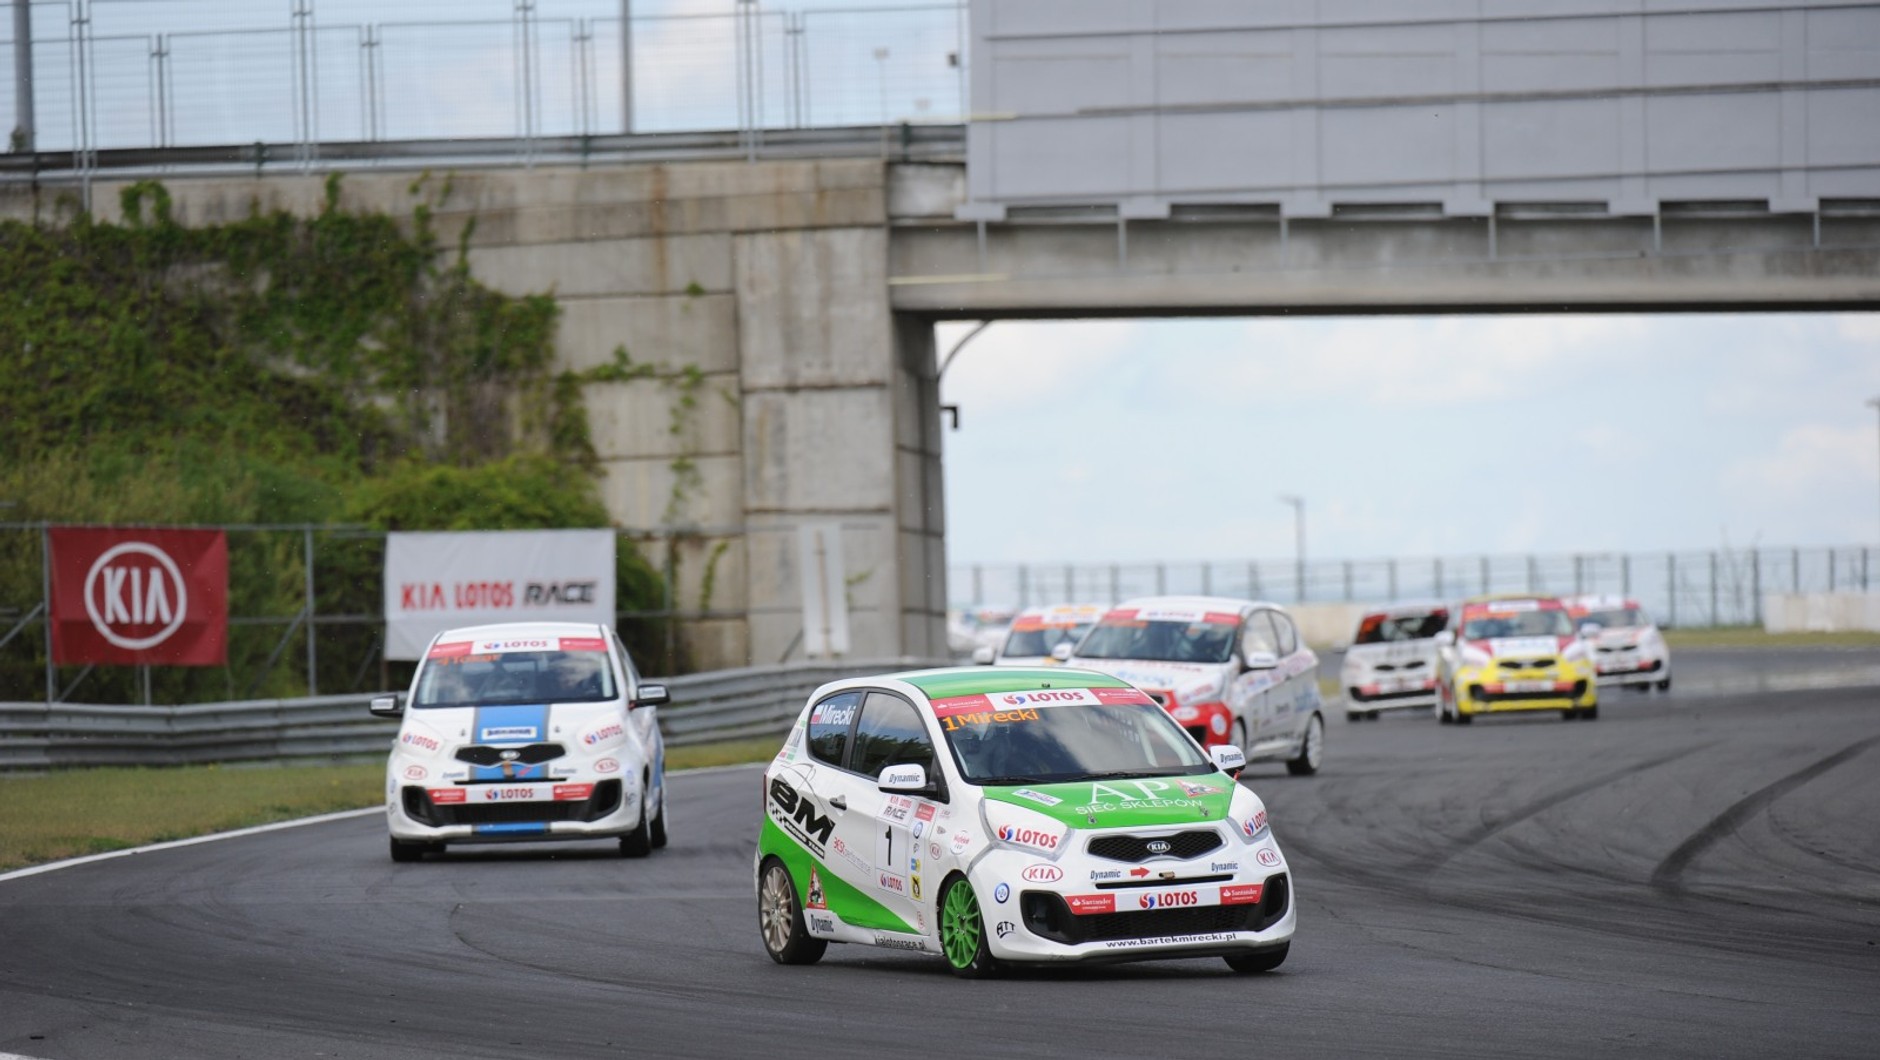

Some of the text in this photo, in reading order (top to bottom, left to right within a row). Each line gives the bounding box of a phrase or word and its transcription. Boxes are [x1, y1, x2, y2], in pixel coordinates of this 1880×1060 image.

[103, 566, 172, 624] KIA
[401, 581, 597, 609] KIA LOTOS RACE
[504, 640, 548, 648] LOTOS
[1028, 691, 1084, 702] LOTOS
[819, 704, 857, 725] Mirecki
[596, 724, 623, 740] LOTOS
[412, 735, 439, 751] LOTOS
[1220, 751, 1243, 764] Dynamic
[888, 773, 921, 784] Dynamic
[501, 788, 534, 799] LOTOS
[1087, 781, 1170, 805] AP
[769, 778, 836, 846] BM
[883, 805, 908, 820] RACE
[885, 825, 893, 866] 1
[1016, 830, 1058, 849] LOTOS
[1151, 842, 1168, 851] KIA
[1260, 852, 1278, 863] KIA
[1028, 868, 1055, 880] KIA
[1211, 861, 1238, 872] Dynamic
[1090, 869, 1121, 880] Dynamic
[887, 874, 903, 892] LOTOS
[1158, 891, 1198, 907] LOTOS
[1231, 889, 1257, 897] Santander
[1081, 898, 1111, 906] Santander
[810, 914, 834, 933] Dynamic
[1106, 933, 1237, 948] www.bartekmirecki.pl
